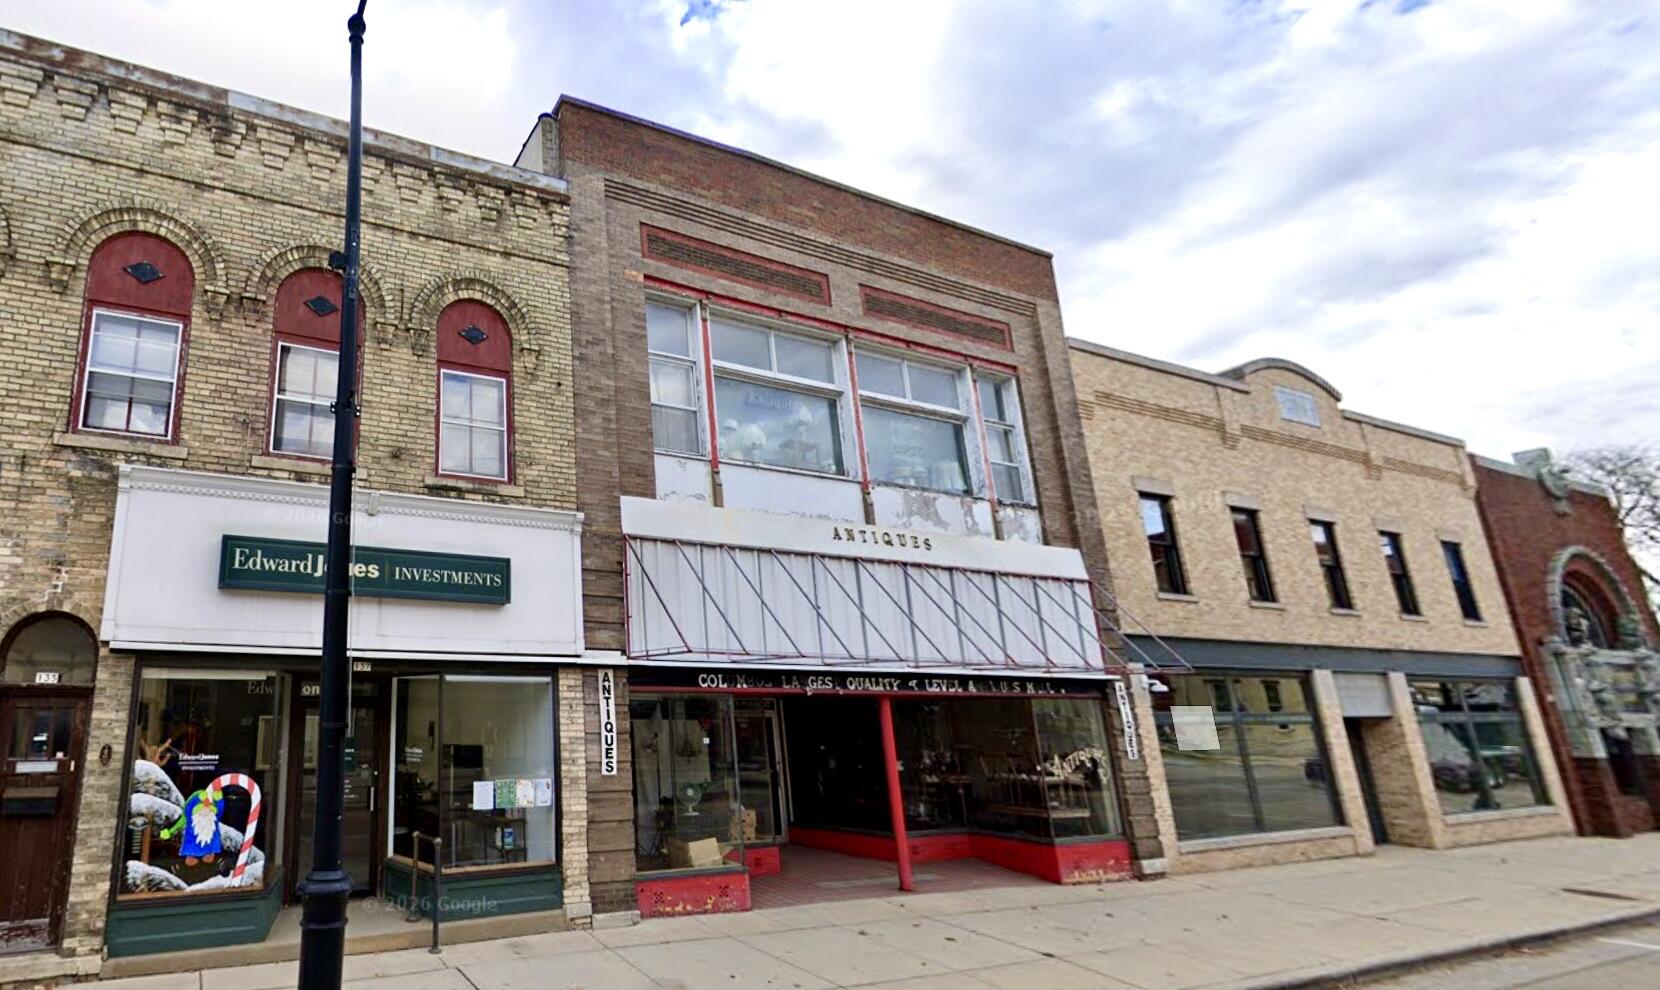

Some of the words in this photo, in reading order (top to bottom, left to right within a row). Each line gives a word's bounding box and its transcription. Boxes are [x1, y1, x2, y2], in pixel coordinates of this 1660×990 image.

[832, 526, 932, 551] ANTIQUES
[232, 547, 380, 578] EdwardJes
[394, 566, 502, 587] INVESTMENTS
[847, 677, 901, 691] QUALITY
[925, 678, 963, 692] LEVEL
[601, 671, 615, 774] ANTIQUES
